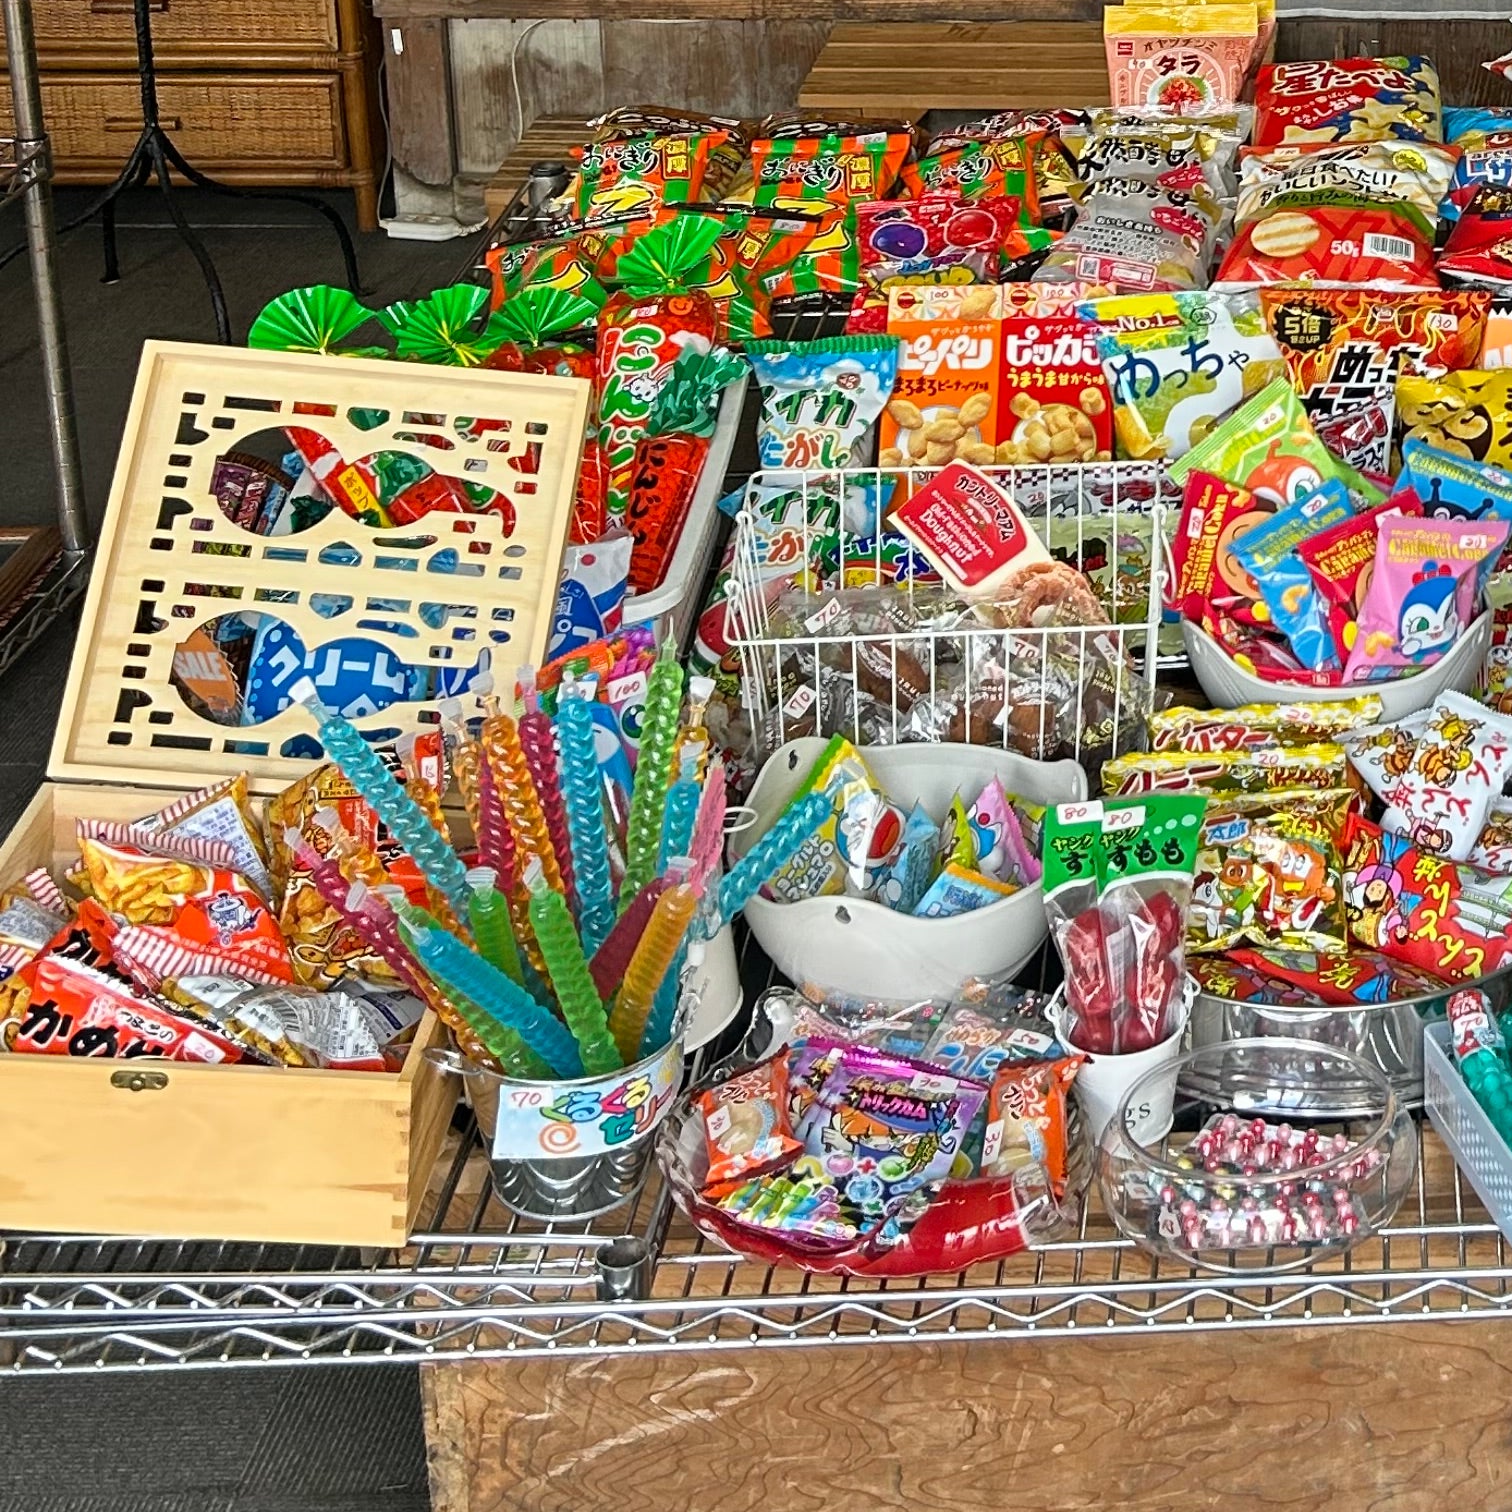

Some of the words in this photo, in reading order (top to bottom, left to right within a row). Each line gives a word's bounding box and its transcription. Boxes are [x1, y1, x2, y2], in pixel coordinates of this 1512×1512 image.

[1156, 55, 1202, 77] タラ
[929, 290, 950, 301] 100
[1117, 314, 1167, 332] No.1
[1284, 314, 1333, 334] 5倍
[1109, 338, 1250, 405] めっちゃ
[172, 652, 229, 681] SALE
[1258, 752, 1280, 766] 20
[1108, 842, 1185, 872] すもも
[511, 1090, 543, 1108] 70
[539, 1079, 652, 1125] ぐるぐる
